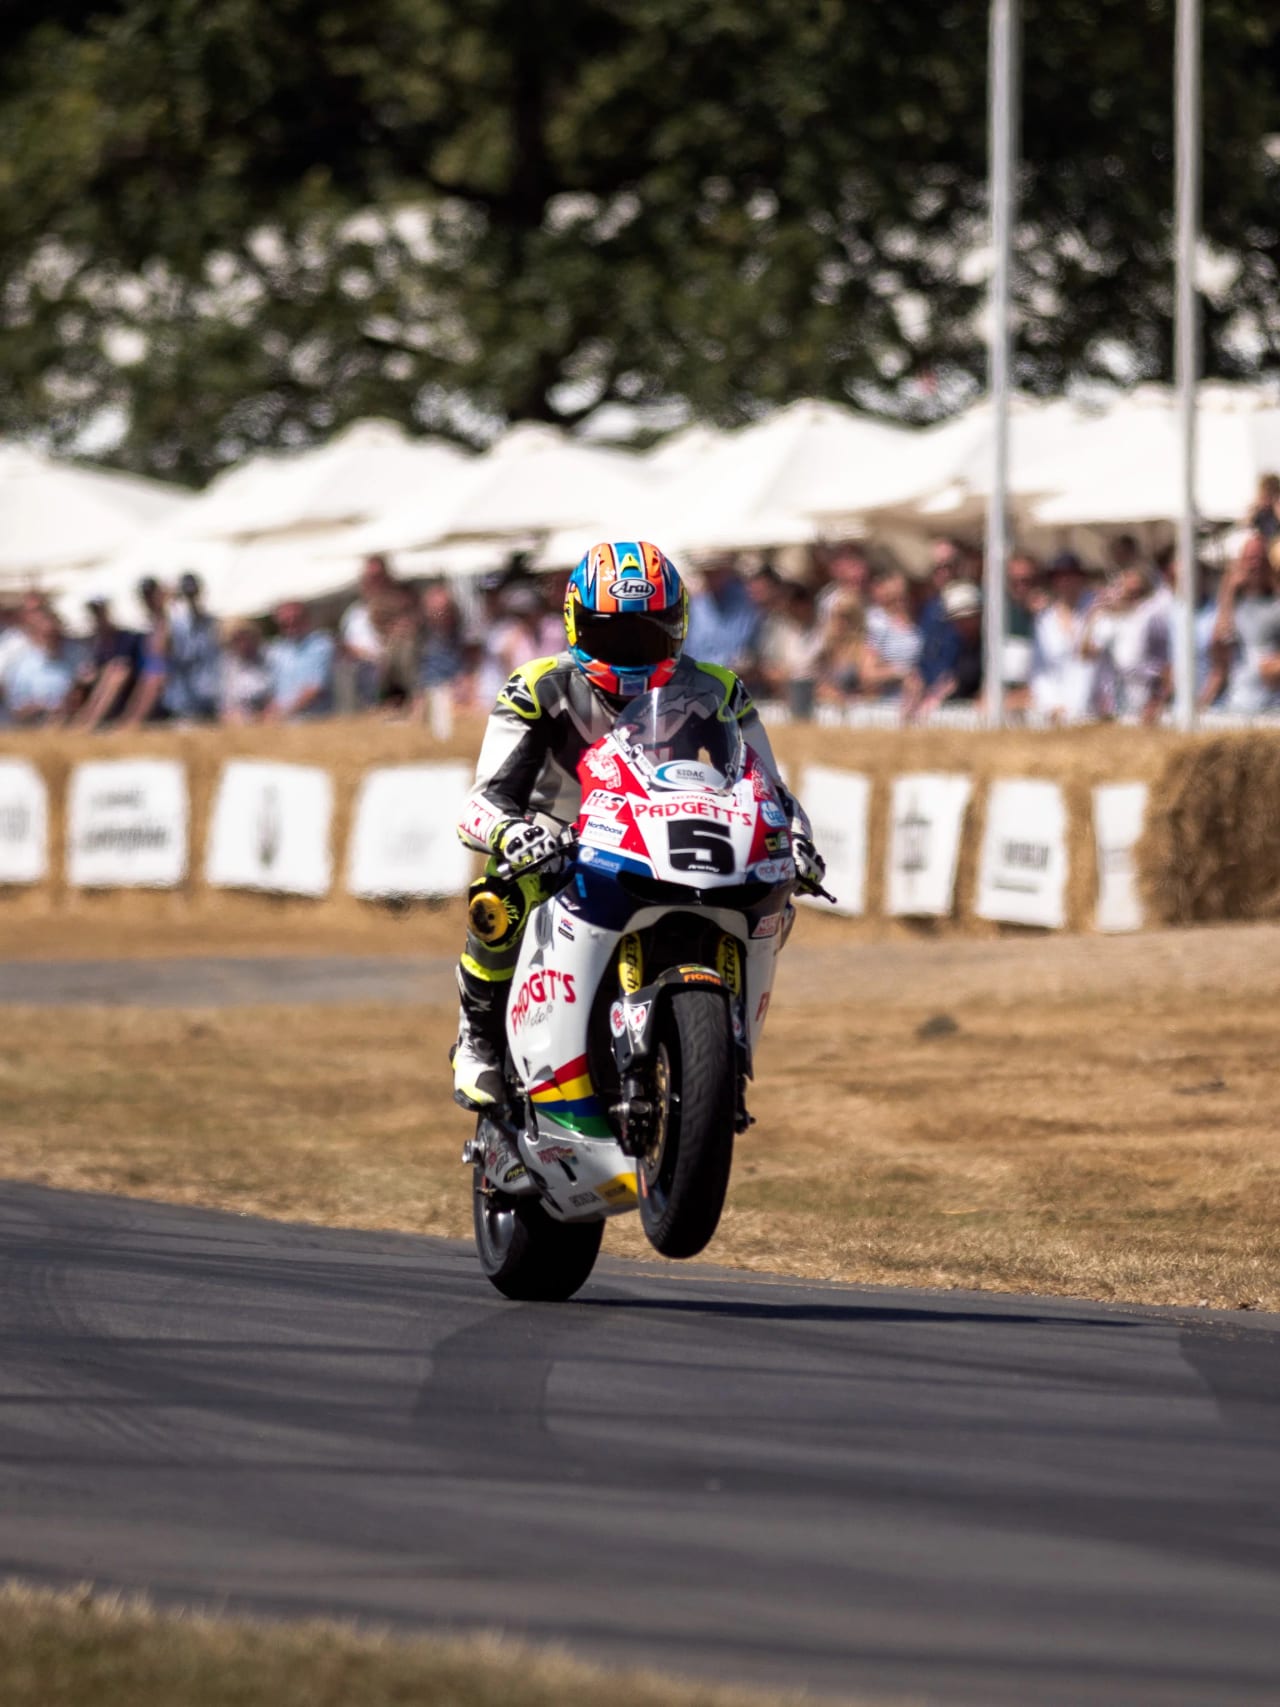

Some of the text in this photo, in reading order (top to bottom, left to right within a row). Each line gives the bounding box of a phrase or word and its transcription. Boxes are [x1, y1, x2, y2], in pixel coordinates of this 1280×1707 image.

[613, 580, 650, 593] Arai
[634, 801, 753, 827] PADGETT'S
[667, 819, 735, 876] 5
